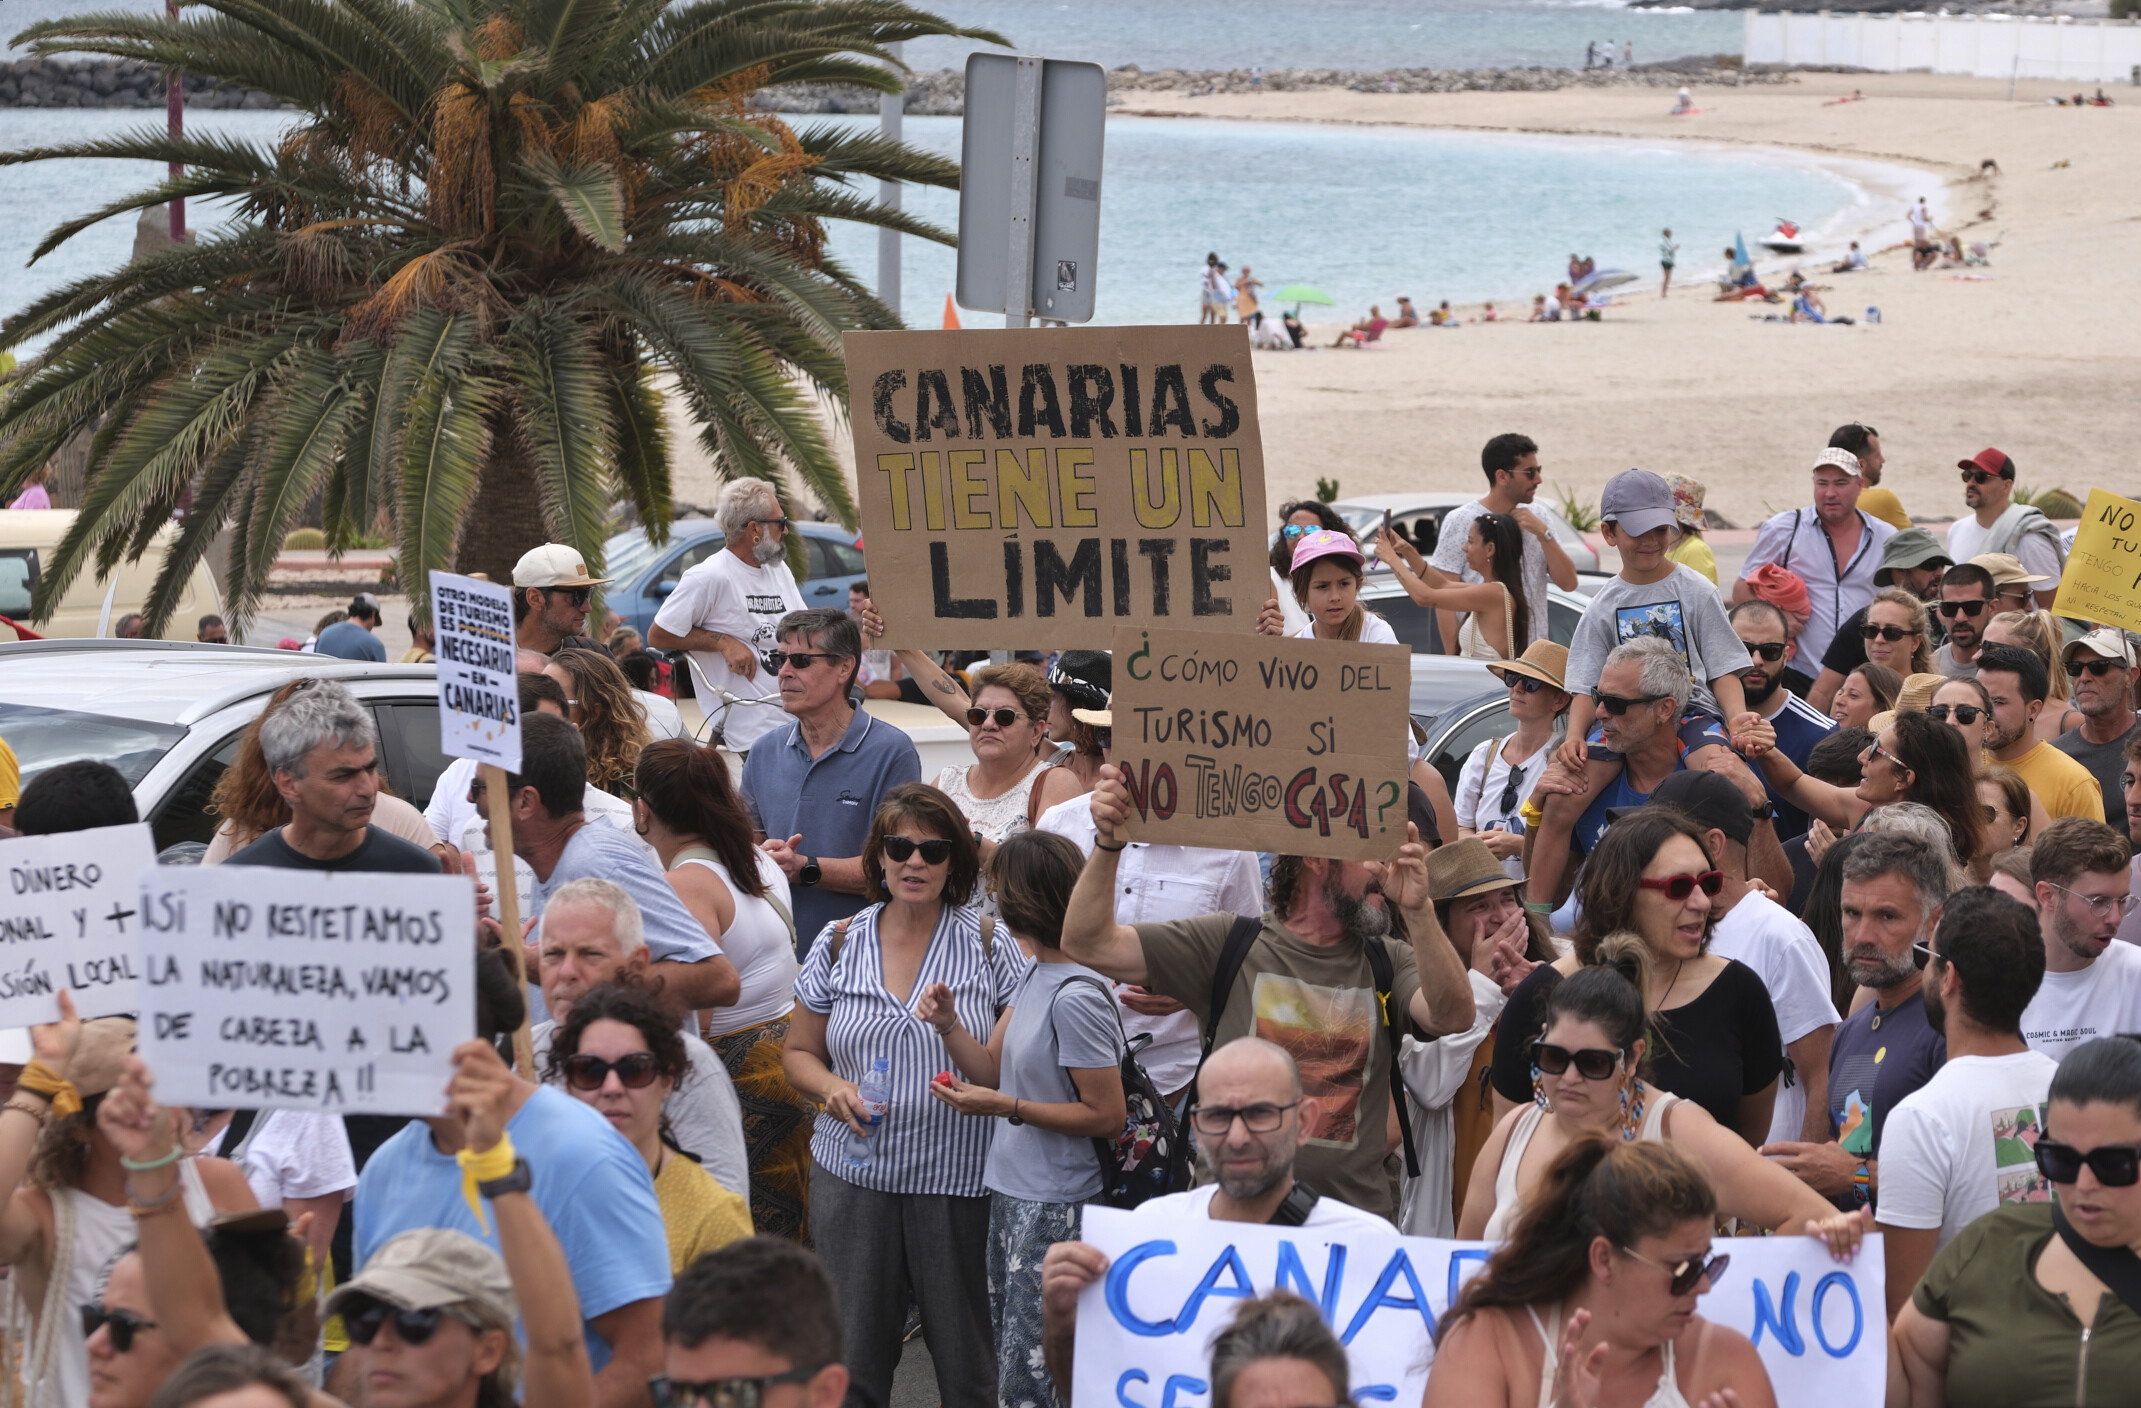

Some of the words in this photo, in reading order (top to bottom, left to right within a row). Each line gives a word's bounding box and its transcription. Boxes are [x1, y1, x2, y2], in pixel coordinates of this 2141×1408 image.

[872, 363, 1240, 443] CANARIAS
[877, 448, 1098, 531] TIENE
[1129, 448, 1246, 529] UN
[2099, 504, 2134, 532] NO
[2081, 552, 2123, 576] TENGO
[2112, 537, 2141, 557] TU
[929, 532, 1233, 619] LÍMITE
[437, 586, 467, 602] OTRO
[469, 592, 508, 613] MODELO
[438, 600, 456, 616] DE
[457, 603, 510, 628] TURISMO
[2085, 602, 2127, 620] RESPETAN
[2104, 590, 2123, 602] LOS
[439, 616, 455, 632] ES
[441, 635, 512, 675] NECESARIO
[1127, 631, 1238, 687] ¿CÓMO
[1341, 664, 1391, 692] DEL
[444, 683, 515, 725] CANARIAS
[1120, 758, 1178, 824] NO
[1185, 754, 1282, 819] TENGO
[1284, 766, 1400, 839] CASA?
[72, 907, 87, 939] Y
[214, 901, 251, 939] NO
[268, 903, 443, 945] RESPETAMOS
[67, 953, 139, 991] LOCAL
[147, 955, 182, 985] LA
[361, 967, 451, 1004] VAMOS
[154, 1012, 194, 1040] DE
[220, 1015, 325, 1051] CABEZA
[348, 1026, 366, 1050] A
[389, 1024, 430, 1054] LA
[2026, 1031, 2051, 1039] COSMIC
[2080, 1027, 2097, 1035] SOUL
[209, 1063, 345, 1105] POBREZA
[1751, 1269, 1864, 1359] NO
